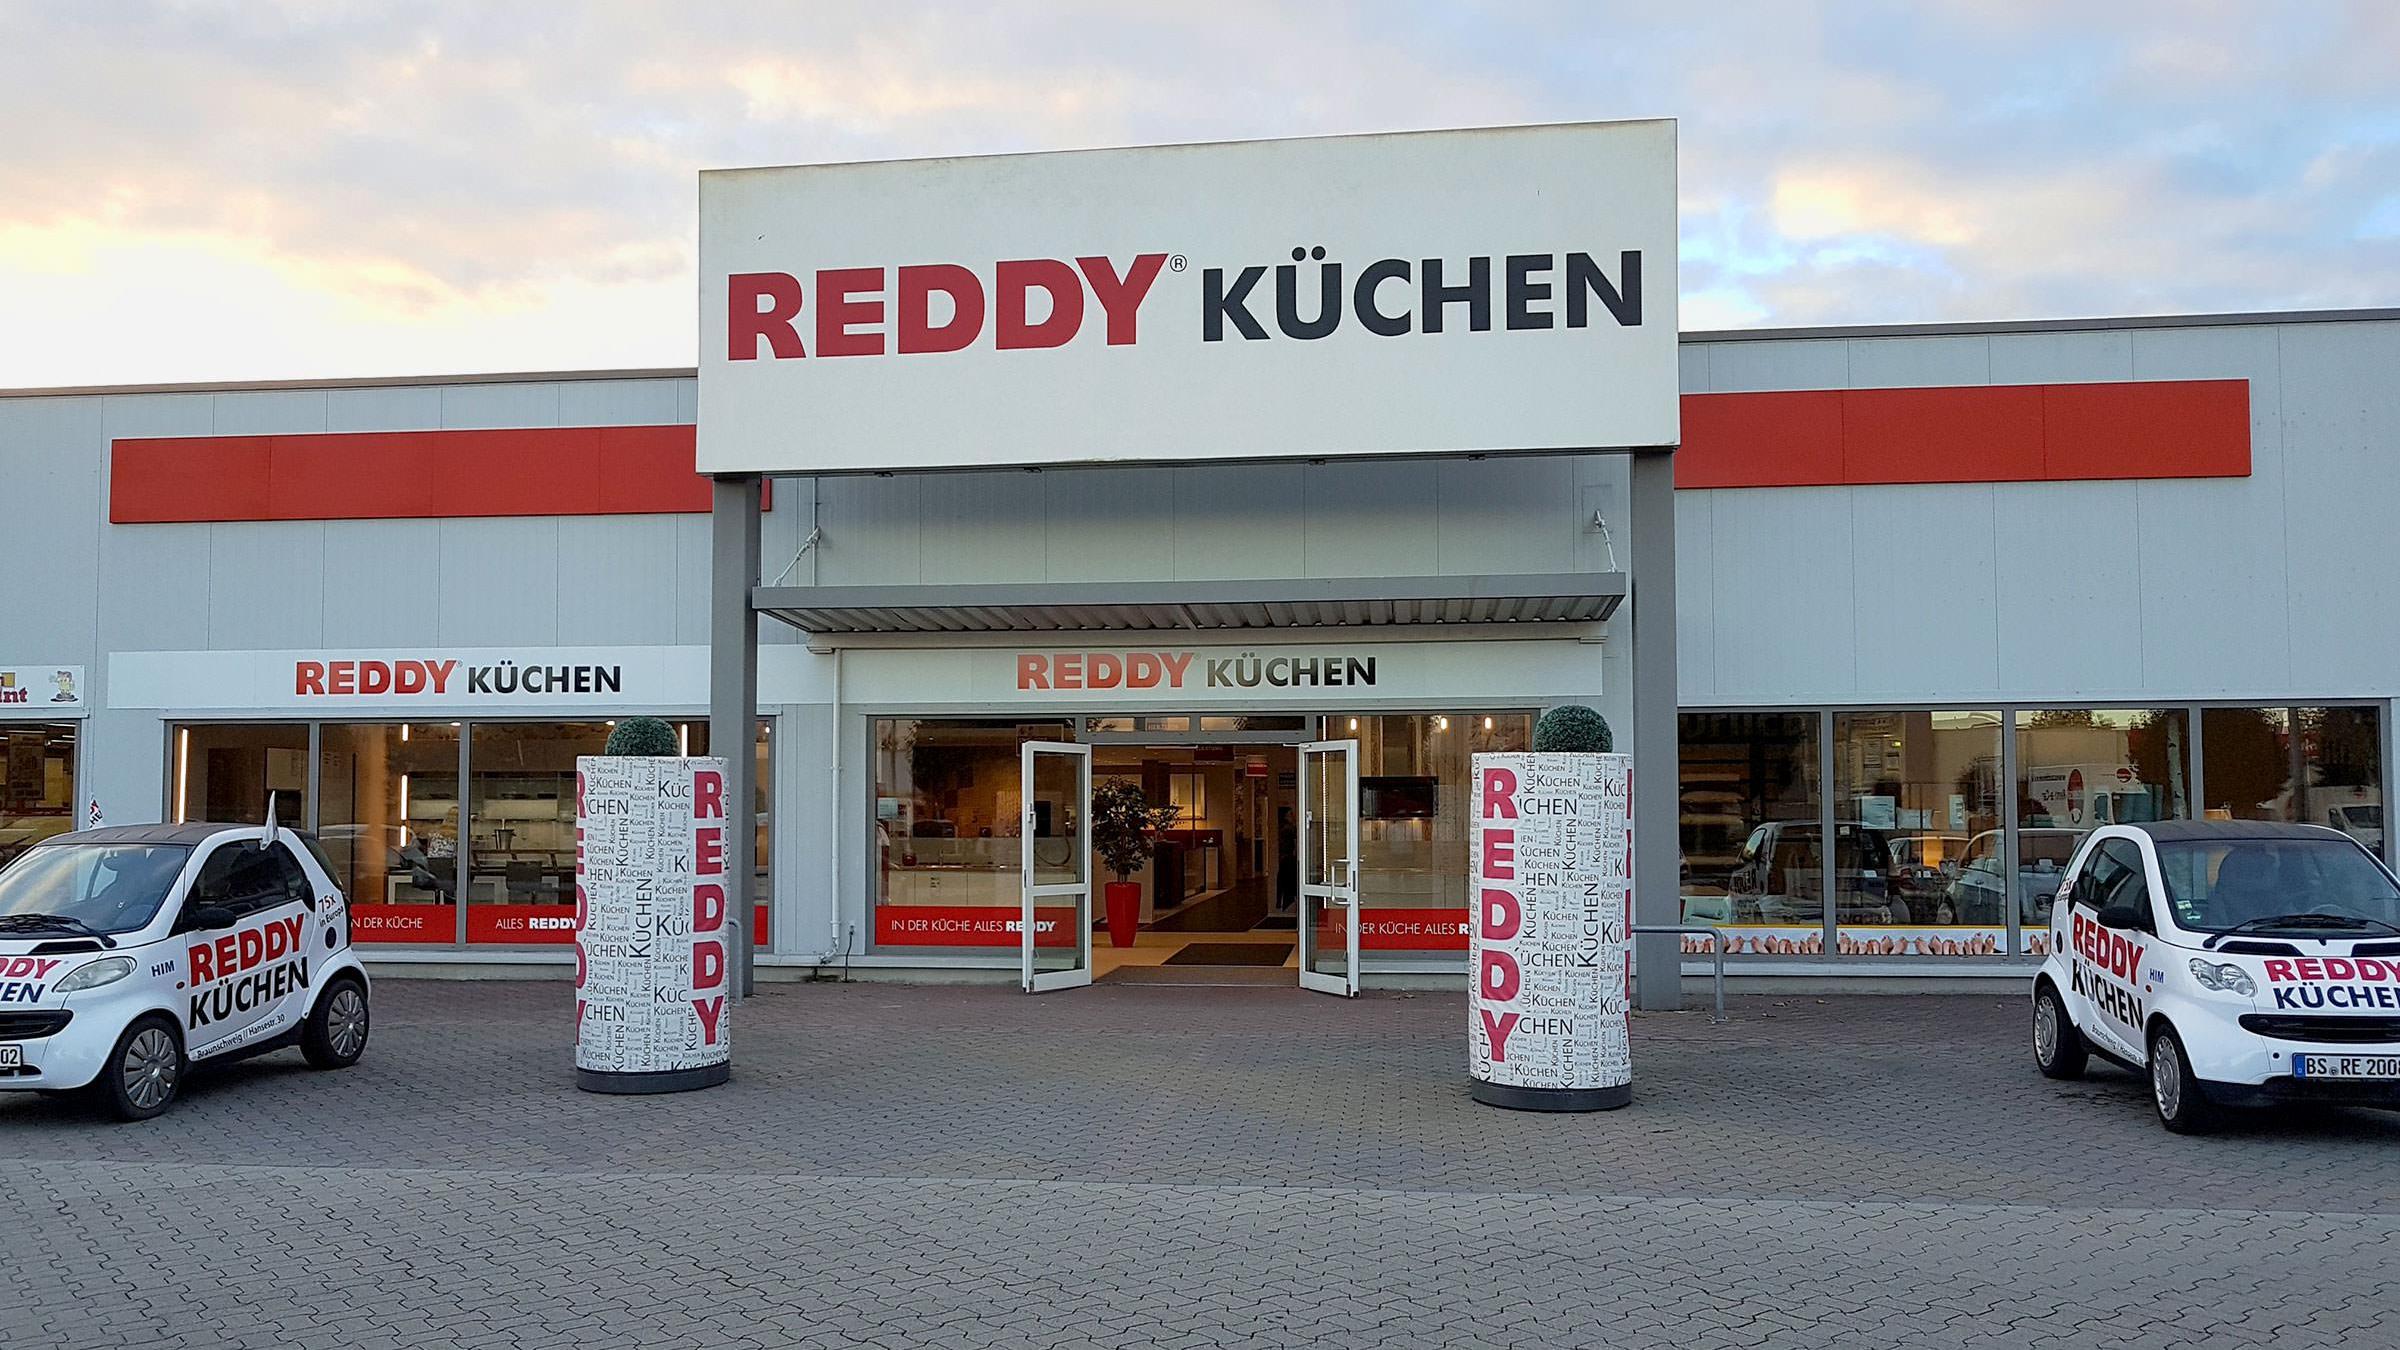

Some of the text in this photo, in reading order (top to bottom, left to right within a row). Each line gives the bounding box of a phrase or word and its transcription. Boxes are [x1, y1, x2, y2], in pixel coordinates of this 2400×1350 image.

[1203, 246, 1642, 342] KÜCHEN
[296, 660, 621, 695] REDDY KÜCHEN
[1017, 652, 1376, 689] REDDY KÜCHEN
[596, 777, 631, 788] KÜCHEN
[1537, 775, 1580, 786] KÜCHEN
[586, 796, 628, 814] CHEN
[658, 802, 690, 810] KÜCHEN
[1562, 818, 1576, 870] KÜCHEN
[620, 868, 653, 877] KÜCHEN
[1525, 860, 1559, 869] KÜCHEN
[1567, 872, 1599, 881] KÜCHEN
[656, 886, 687, 894] KÜCHEN
[318, 894, 336, 913] 75x
[601, 905, 630, 913] KÜCHEN
[692, 771, 725, 1046] REDDY
[629, 878, 652, 958] KÜCHEN
[1480, 768, 1521, 1062] REDDY
[1523, 888, 1536, 938] KÜCHEN
[1543, 911, 1578, 920] KÜCHEN
[364, 918, 383, 929] DER
[386, 917, 423, 929] KÜCHE
[496, 918, 524, 929] ALLES
[529, 918, 576, 929] REDDY
[892, 920, 904, 931] IN
[908, 920, 928, 931] DER
[932, 918, 970, 932] KÜCHE
[974, 920, 1003, 932] ALLES
[1379, 921, 1420, 935] KÜCHE
[1424, 923, 1455, 935] ALLES
[1577, 883, 1598, 967] KÜCHEN
[600, 933, 628, 942] KÜCHEN
[188, 913, 304, 987] REDDY
[1542, 941, 1576, 951] KÜCHEN
[2072, 912, 2144, 986] REDDY
[151, 960, 175, 977] HIM
[2149, 968, 2164, 984] HIM
[189, 957, 310, 1030] KÜCHEN
[593, 983, 627, 995] KÜCHEN
[2072, 958, 2144, 1032] KÜCHEN
[1532, 994, 1575, 1007] KÜCHEN
[654, 1007, 686, 1016] KÜCHEN
[197, 1034, 242, 1058] Braunschweig
[1515, 1063, 1557, 1077] KÜCHEN
[2307, 1058, 2327, 1074] BS
[2341, 1059, 2361, 1075] RE
